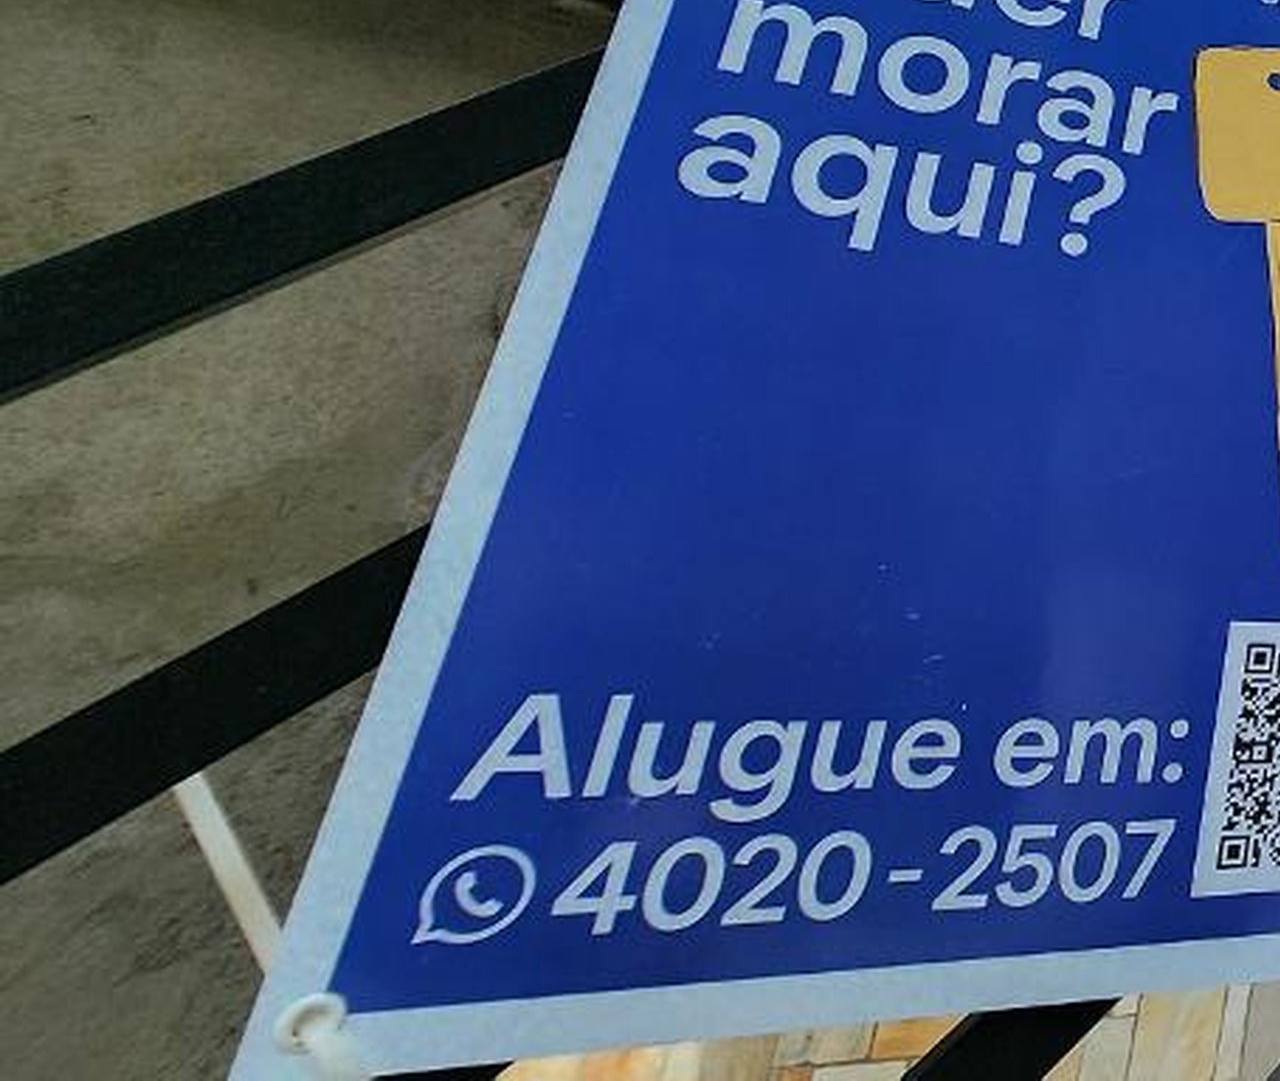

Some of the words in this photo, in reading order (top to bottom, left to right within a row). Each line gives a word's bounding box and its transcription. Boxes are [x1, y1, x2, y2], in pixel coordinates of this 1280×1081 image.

[677, 115, 1127, 257] aqui?
[450, 693, 963, 823] Alugue
[993, 716, 1192, 787] em:
[551, 818, 1177, 937] 4020-2507
